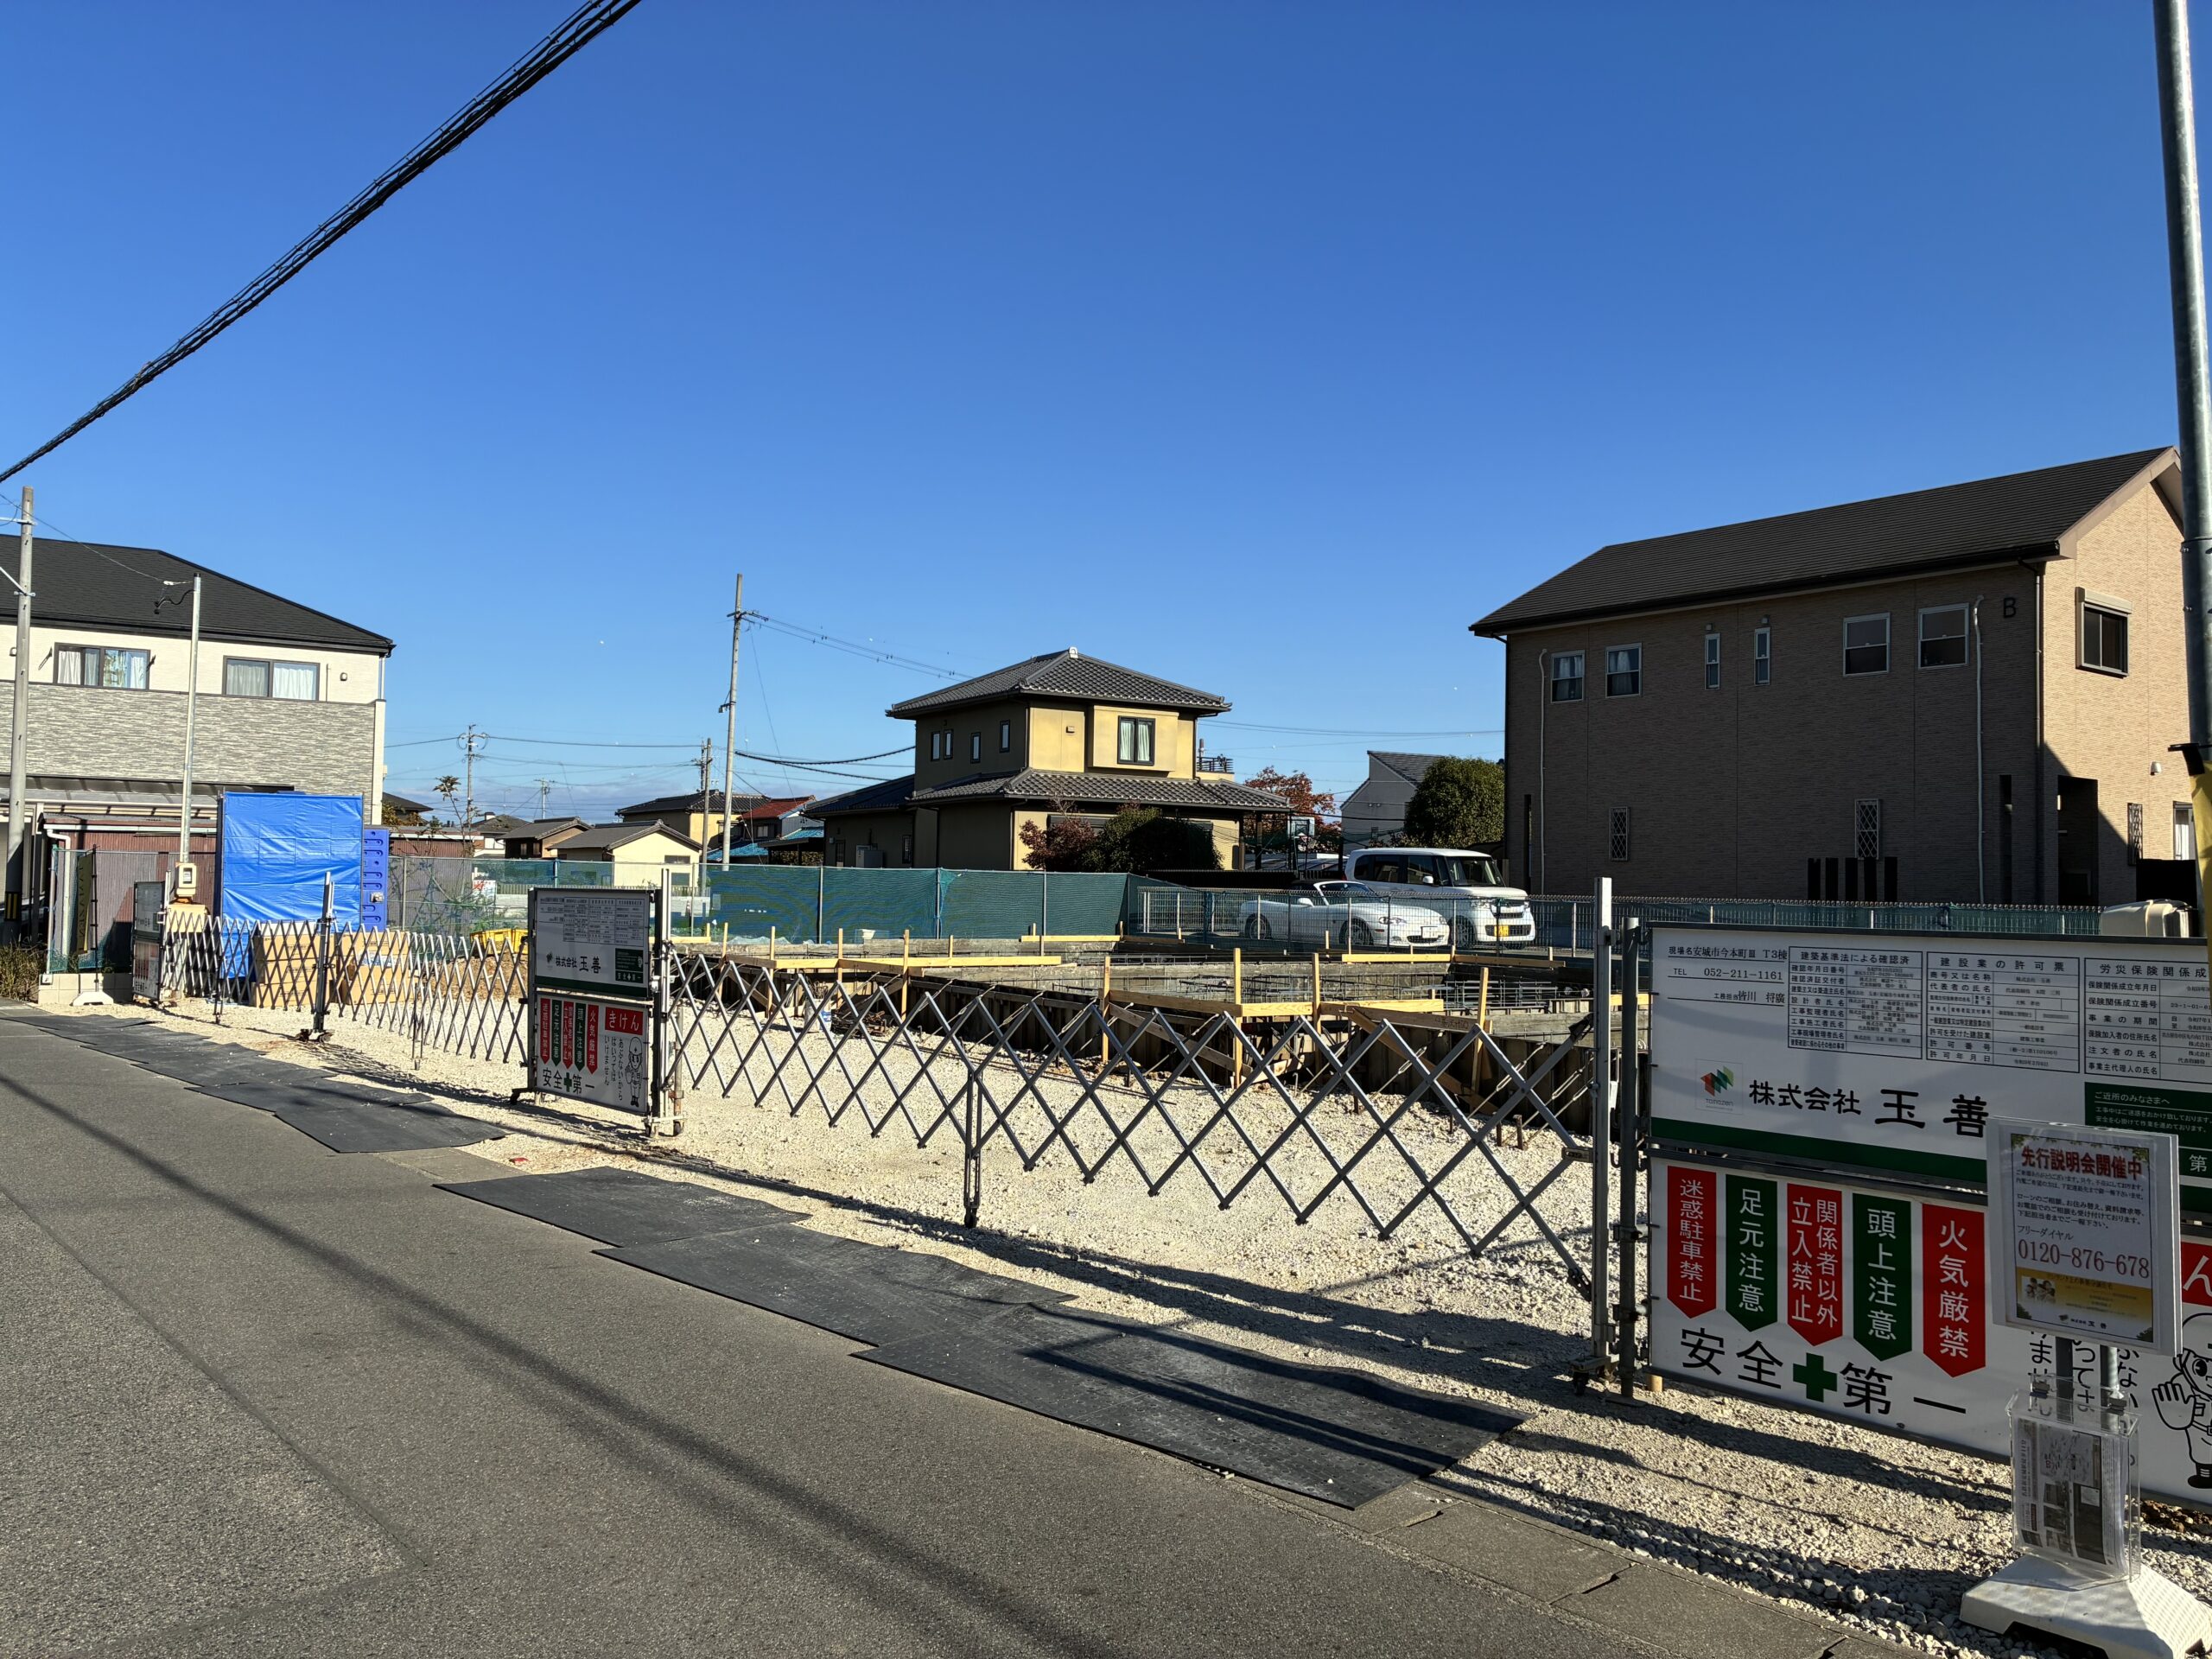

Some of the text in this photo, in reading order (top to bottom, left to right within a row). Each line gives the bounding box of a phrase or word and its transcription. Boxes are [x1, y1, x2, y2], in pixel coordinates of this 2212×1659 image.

[2004, 597, 2016, 618] B
[609, 1010, 639, 1031] きけん
[543, 1067, 594, 1095] 安全 第一
[1749, 1079, 1861, 1116] 株式会社
[2094, 1091, 2170, 1104] ご近所のみなさまへ
[2021, 1145, 2143, 1180] 先行説明会開催中
[1679, 1179, 1704, 1303] 迷惑駐車禁止
[1738, 1188, 1764, 1313] 足元注意
[2018, 1225, 2074, 1241] フリーダイヤル
[1791, 1197, 1814, 1324] 立入禁止
[1816, 1198, 1839, 1328] 関係者以外
[1866, 1208, 1897, 1340] 頭上注意
[2018, 1238, 2150, 1279] 0120-876-678
[1938, 1220, 1969, 1358] 火気厳禁
[1681, 1327, 1783, 1389] 安全
[1840, 1361, 1967, 1415] 第一
